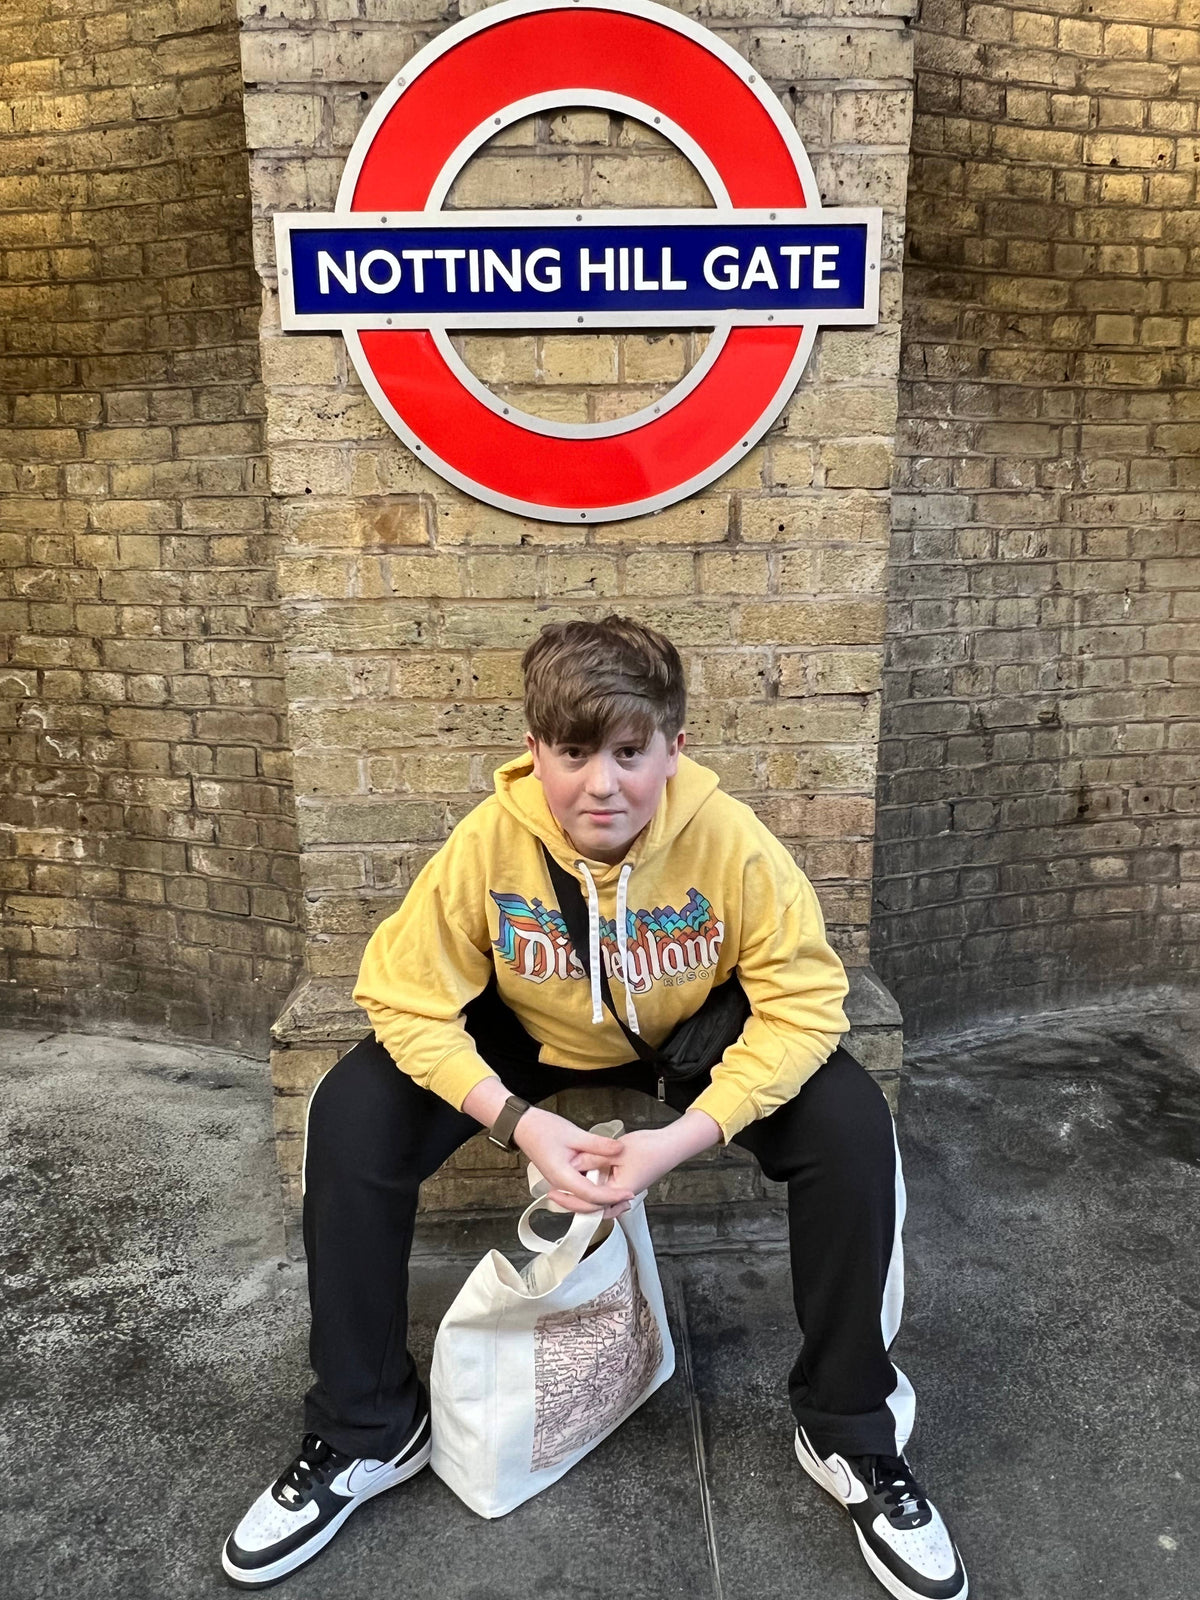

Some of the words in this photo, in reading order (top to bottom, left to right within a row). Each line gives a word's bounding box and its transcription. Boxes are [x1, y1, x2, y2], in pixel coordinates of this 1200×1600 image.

[317, 247, 562, 295] NOTTING
[579, 246, 687, 292] HILL
[703, 245, 840, 291] GATE
[663, 969, 715, 987] RESO
